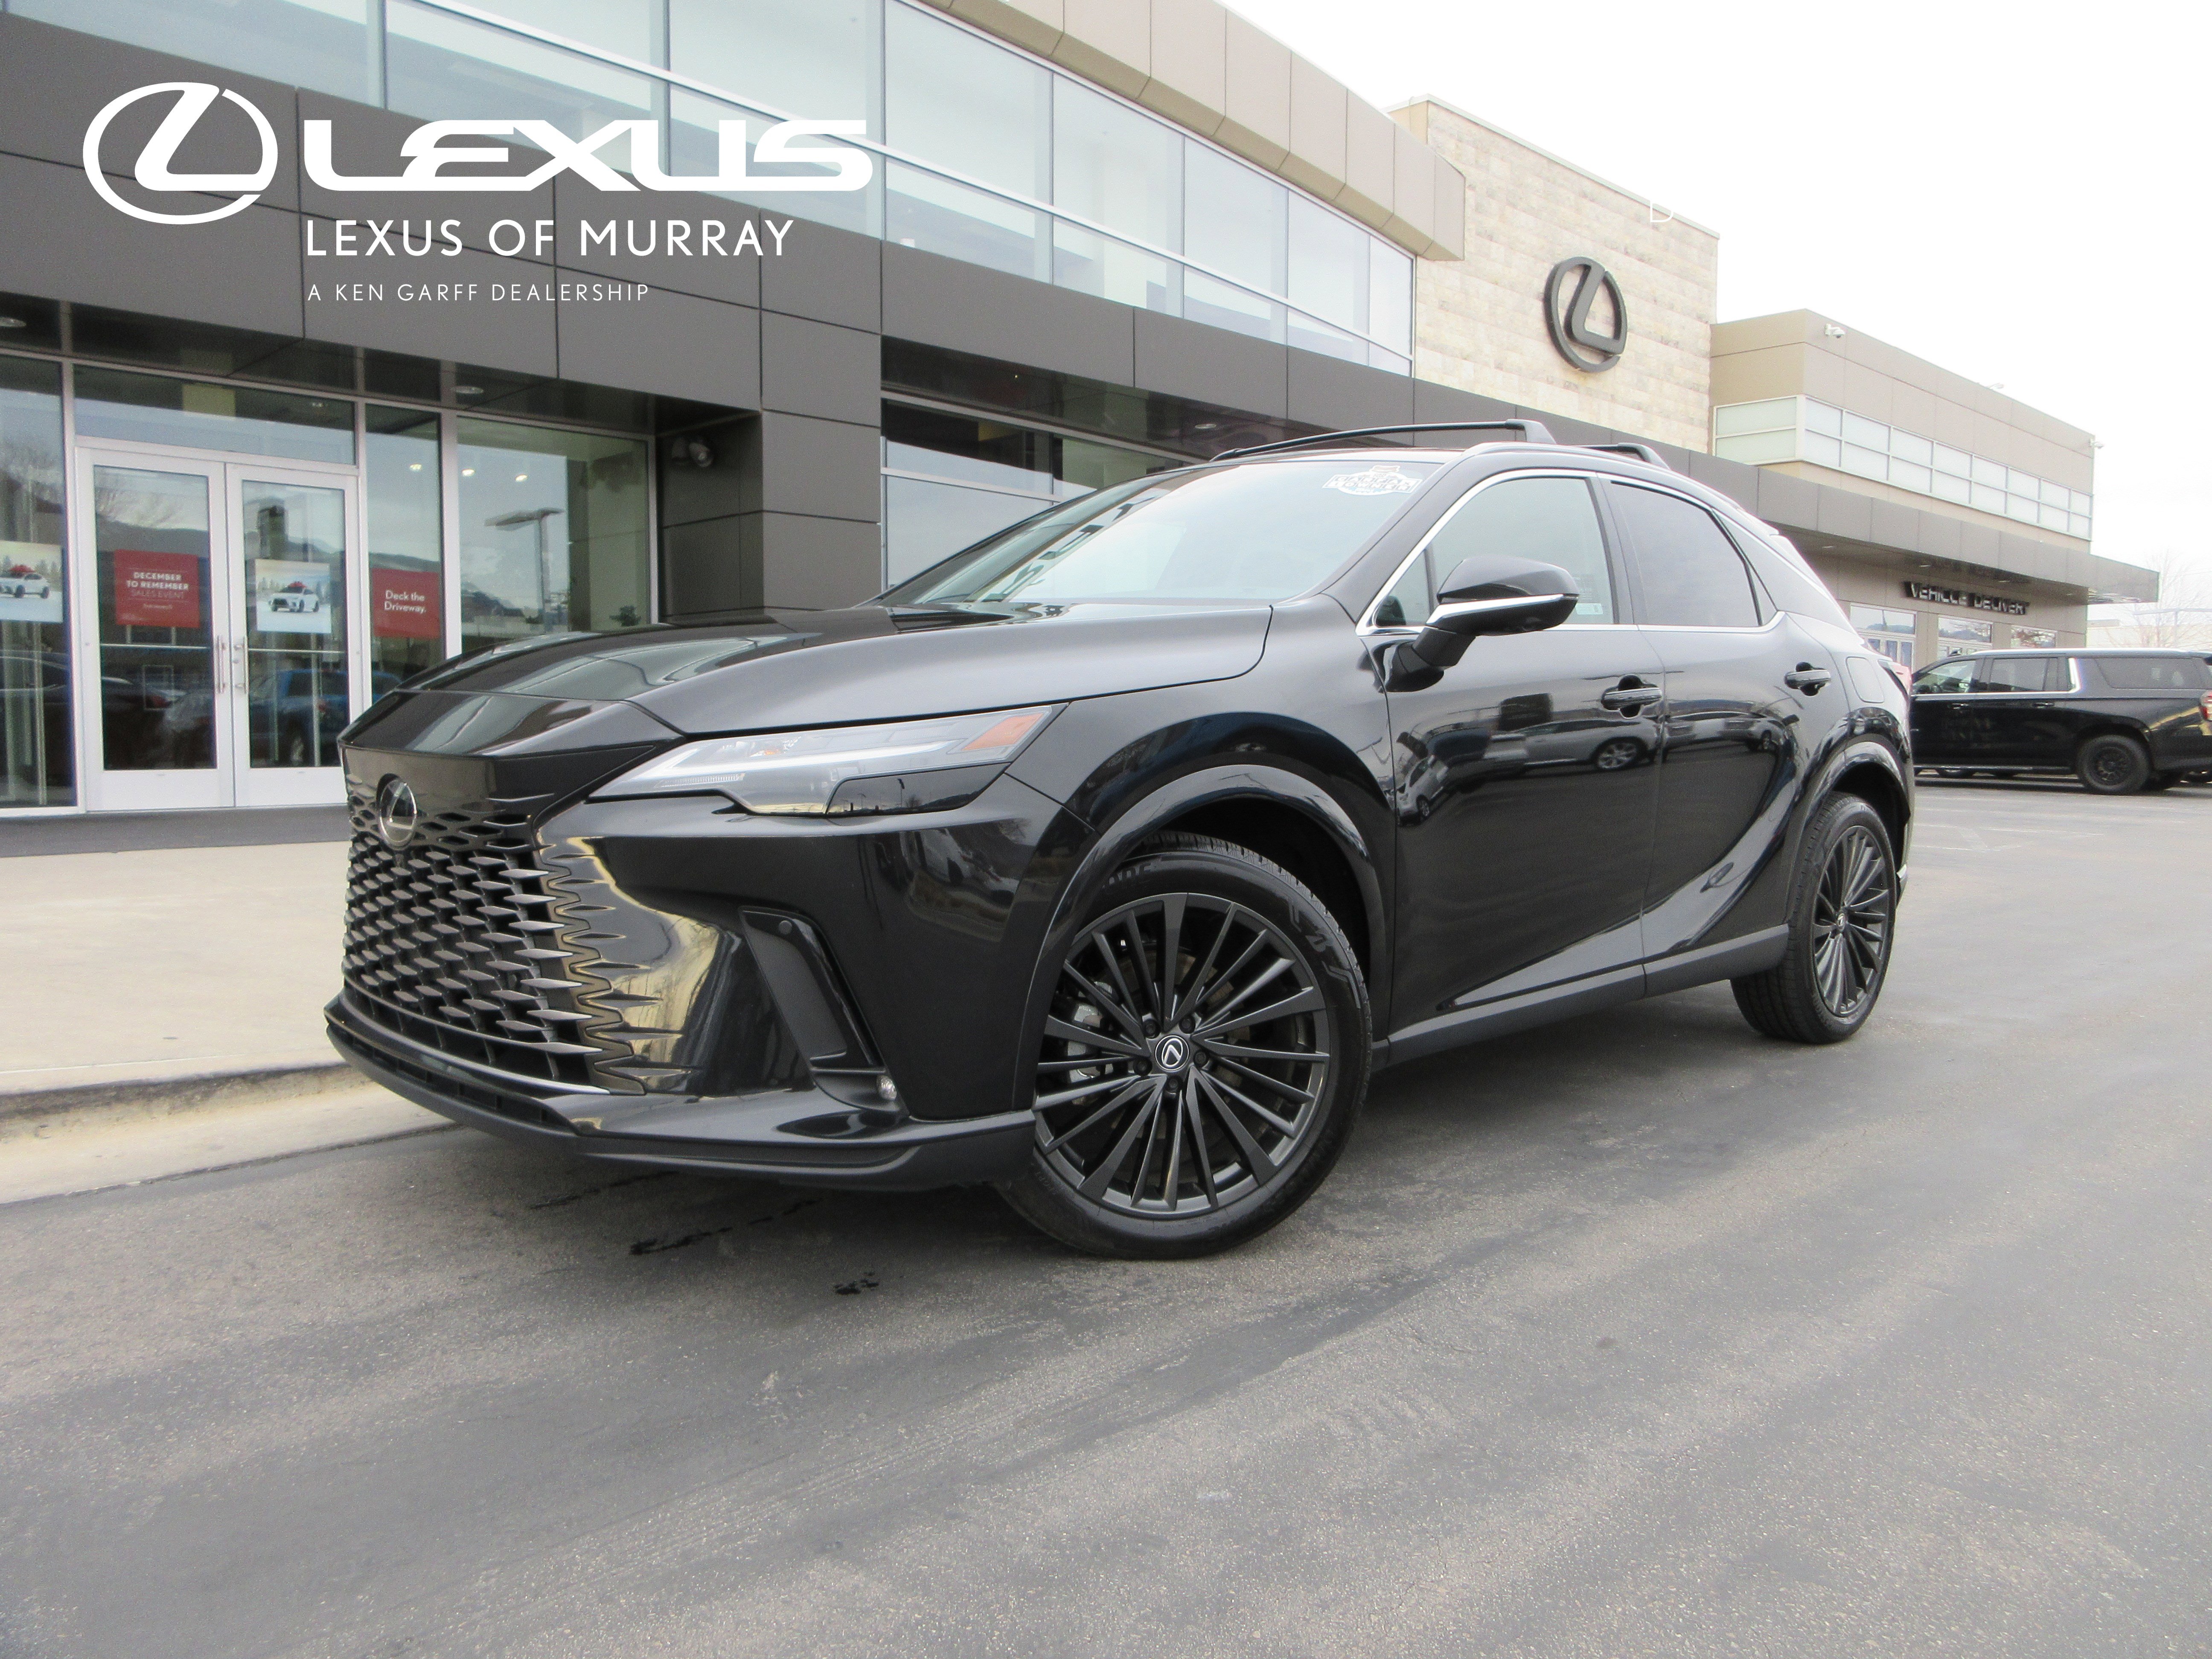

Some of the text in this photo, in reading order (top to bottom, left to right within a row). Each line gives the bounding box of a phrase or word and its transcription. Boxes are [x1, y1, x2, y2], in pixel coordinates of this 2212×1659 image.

[134, 572, 182, 581] DECEMBER
[141, 581, 189, 590] REMEMBER
[386, 590, 425, 601] Deck the
[384, 601, 426, 614] Driveway.
